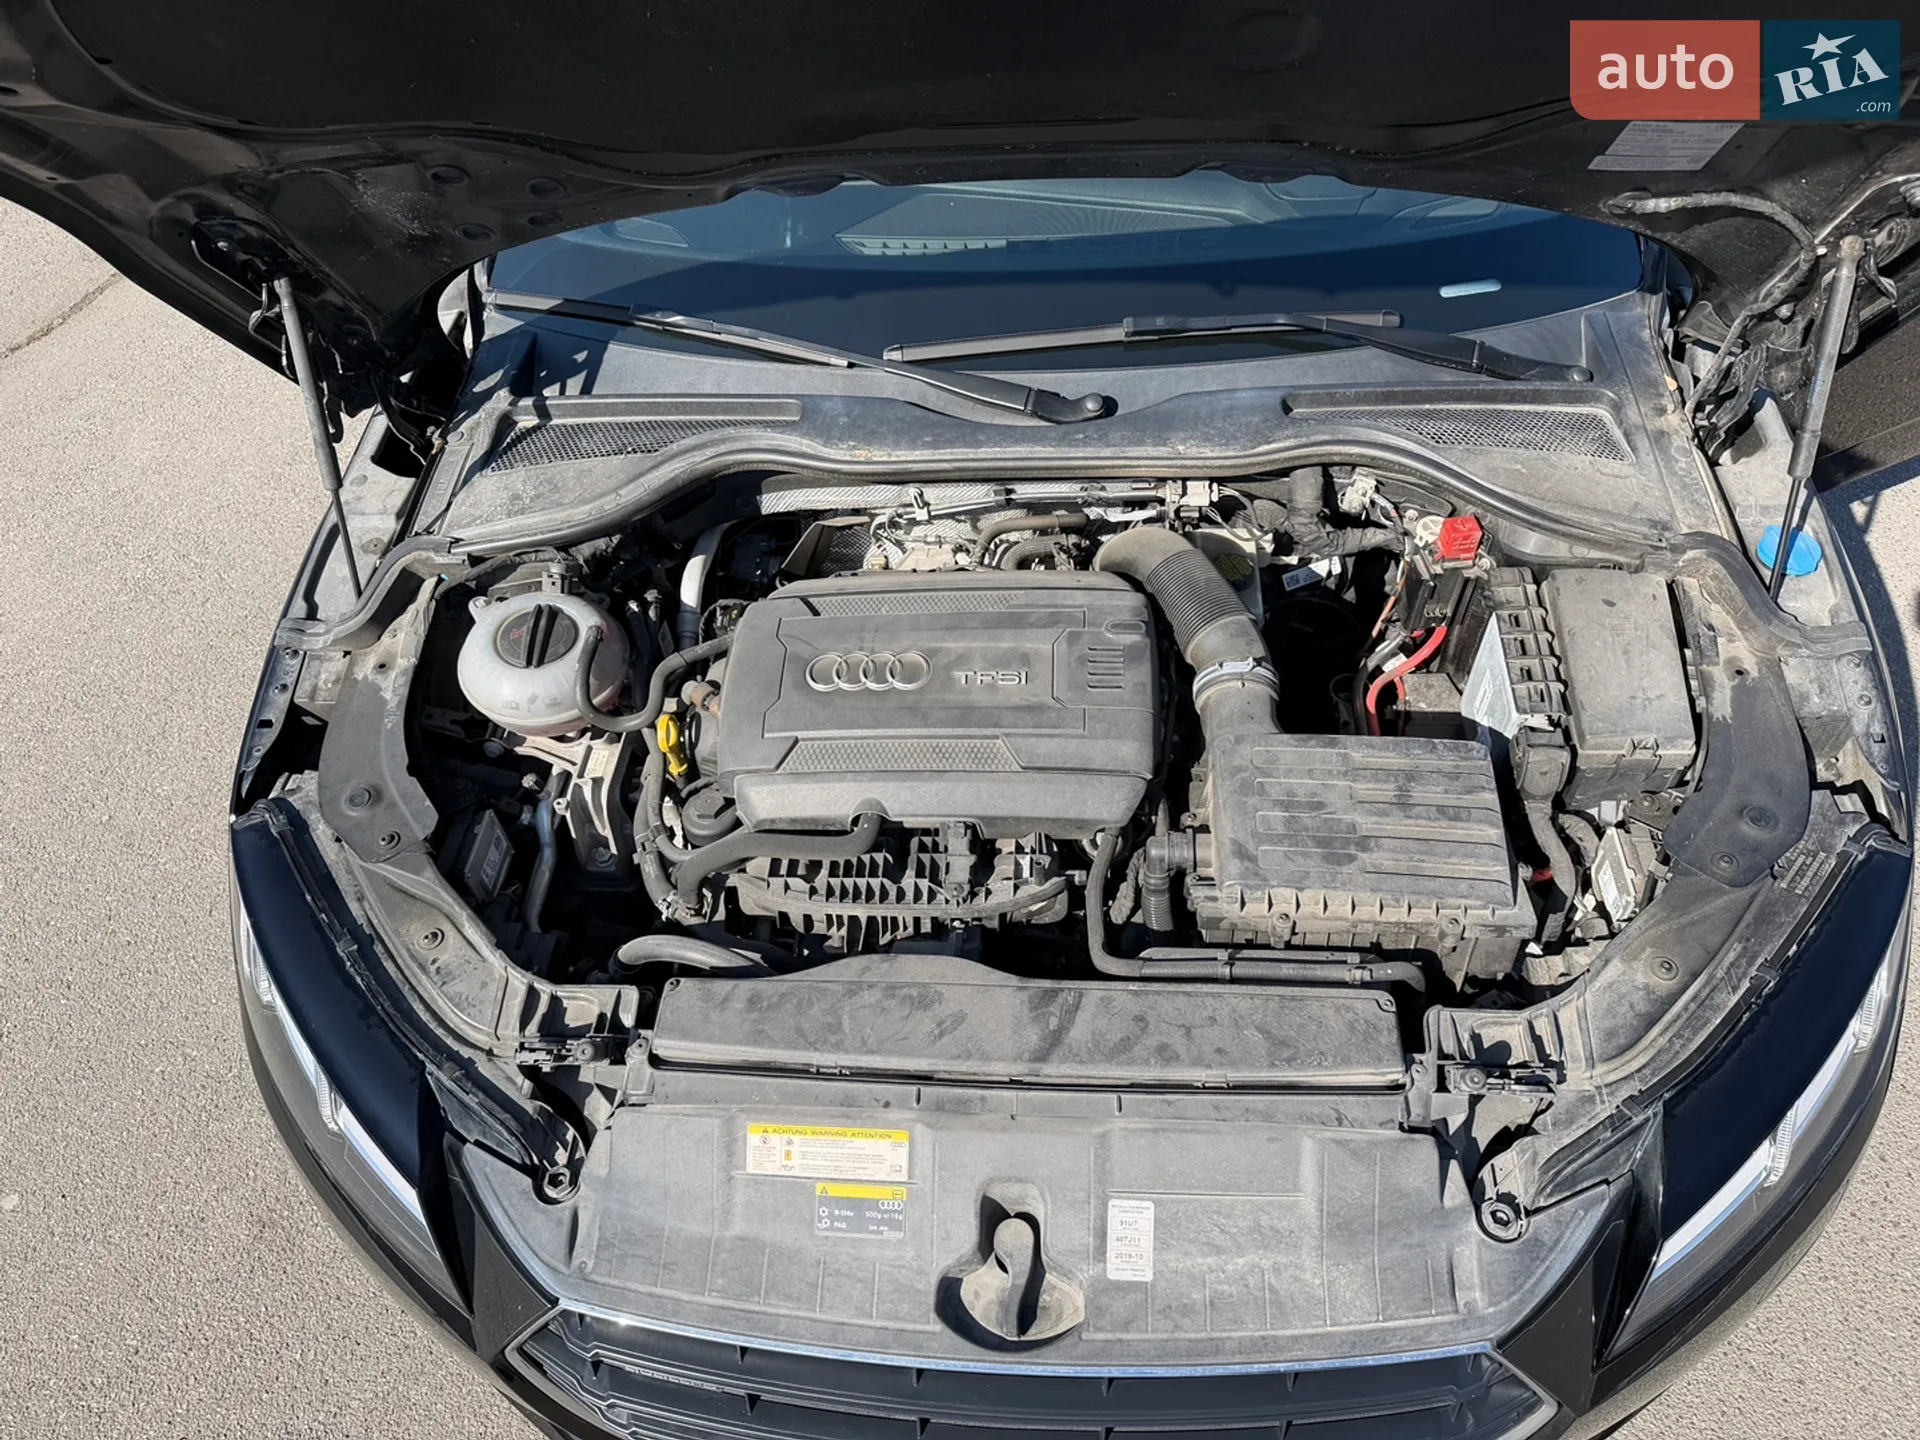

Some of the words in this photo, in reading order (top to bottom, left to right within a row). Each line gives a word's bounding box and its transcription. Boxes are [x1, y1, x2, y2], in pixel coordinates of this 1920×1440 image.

[953, 669, 1028, 686] TFSI
[851, 1131, 892, 1139] ATTENTION
[1119, 1219, 1138, 1227] 91U7
